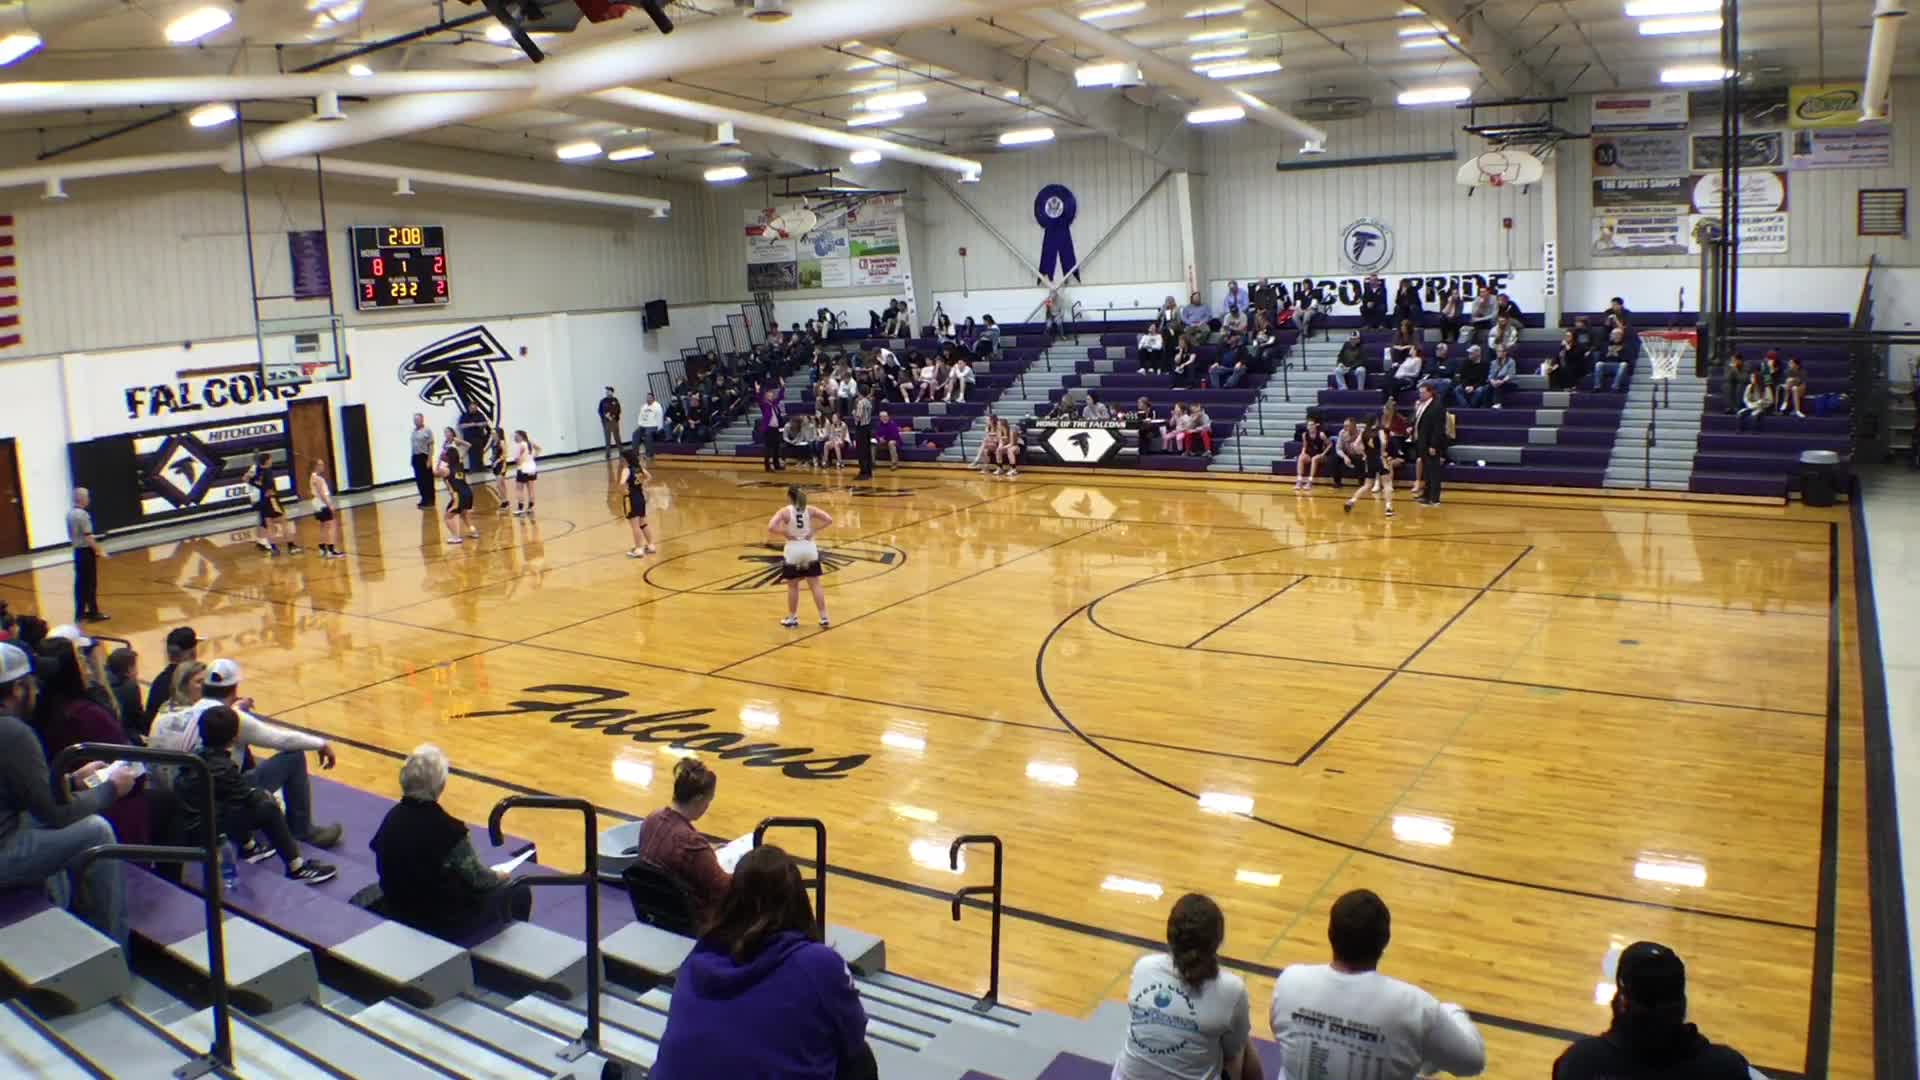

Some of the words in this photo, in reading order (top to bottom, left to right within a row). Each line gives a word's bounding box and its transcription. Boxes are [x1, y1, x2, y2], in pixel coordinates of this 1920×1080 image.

[388, 227, 421, 245] 2:08
[372, 258, 384, 277] 8
[402, 260, 407, 273] 1
[433, 256, 444, 274] 2
[365, 284, 374, 298] 3
[391, 282, 407, 297] 23
[409, 281, 418, 296] 2
[436, 280, 445, 295] 2
[124, 372, 302, 419] FALCONS
[208, 423, 278, 442] HITCHCOCK
[1035, 420, 1058, 428] HOME
[1072, 421, 1087, 429] THE
[1088, 420, 1126, 429] FALCONS
[796, 514, 804, 528] 5
[450, 683, 871, 780] Falcons
